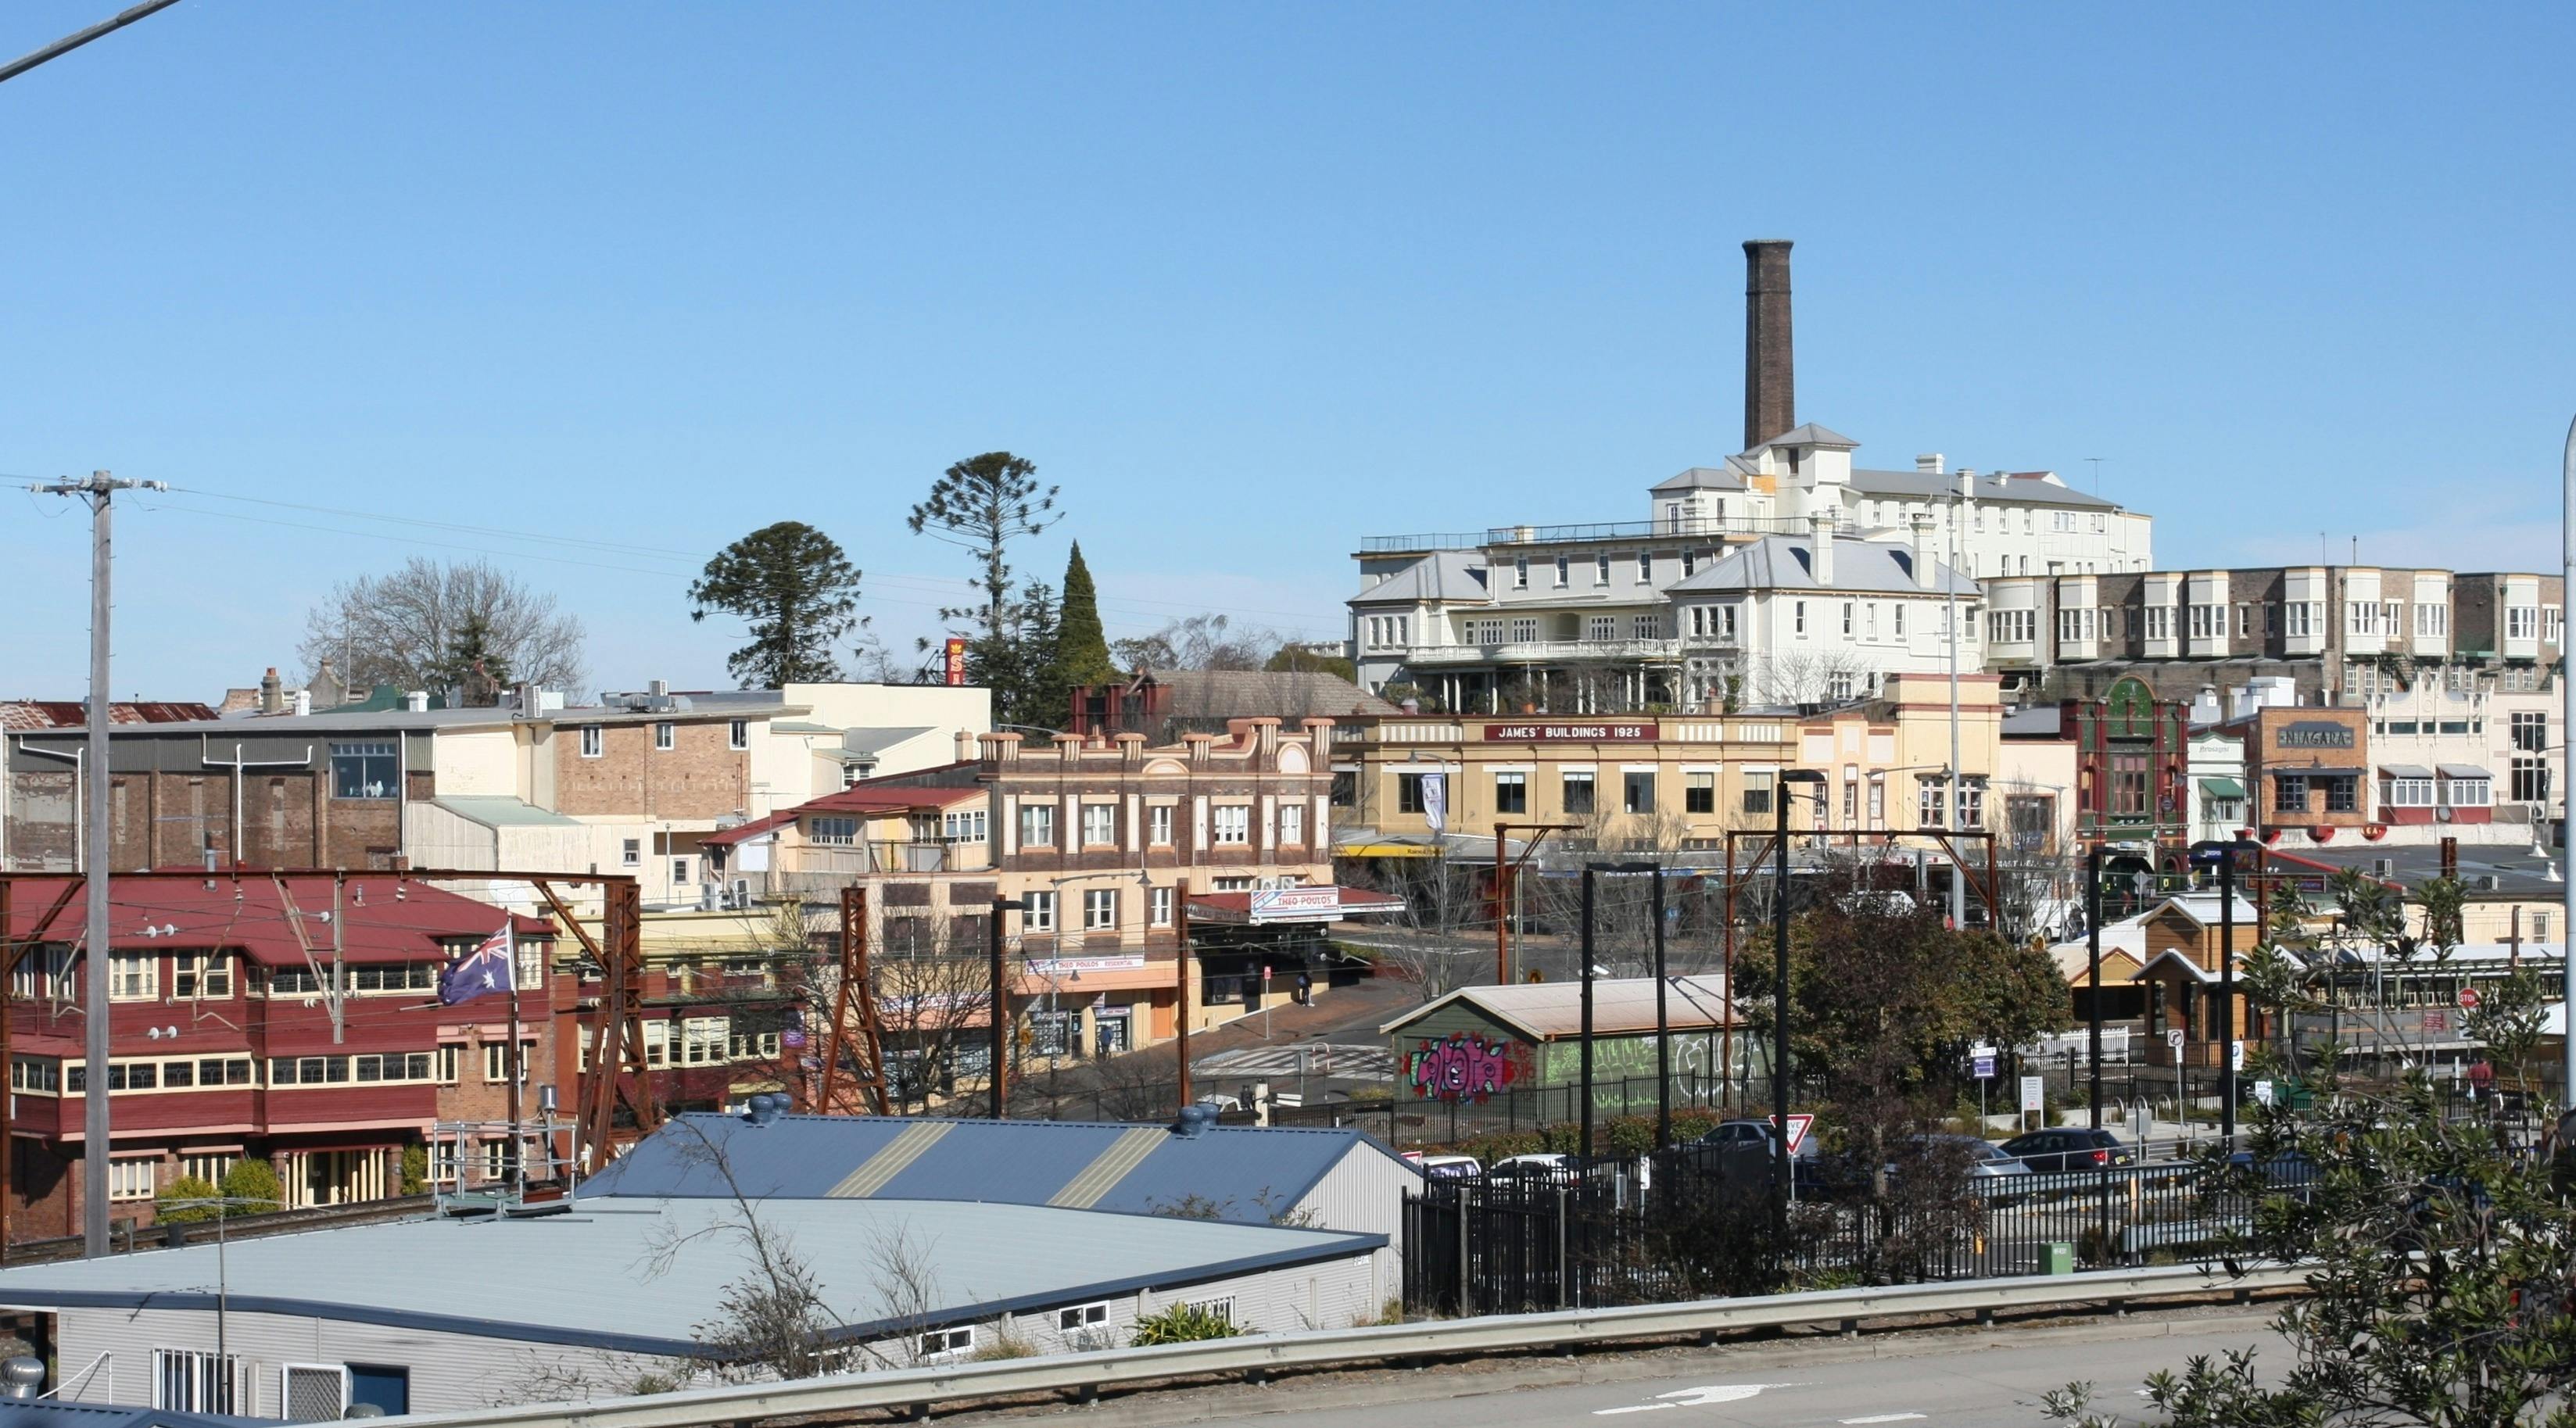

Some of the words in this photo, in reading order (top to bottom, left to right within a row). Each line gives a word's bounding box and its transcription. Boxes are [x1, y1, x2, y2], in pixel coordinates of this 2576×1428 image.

[1498, 727, 1540, 738] JAMES'
[1545, 727, 1607, 738] BUILDINGS
[1614, 727, 1641, 737] 1925
[2286, 731, 2346, 745] NIAGARA
[1278, 897, 1298, 906] THEO
[1301, 896, 1331, 905] POULOS
